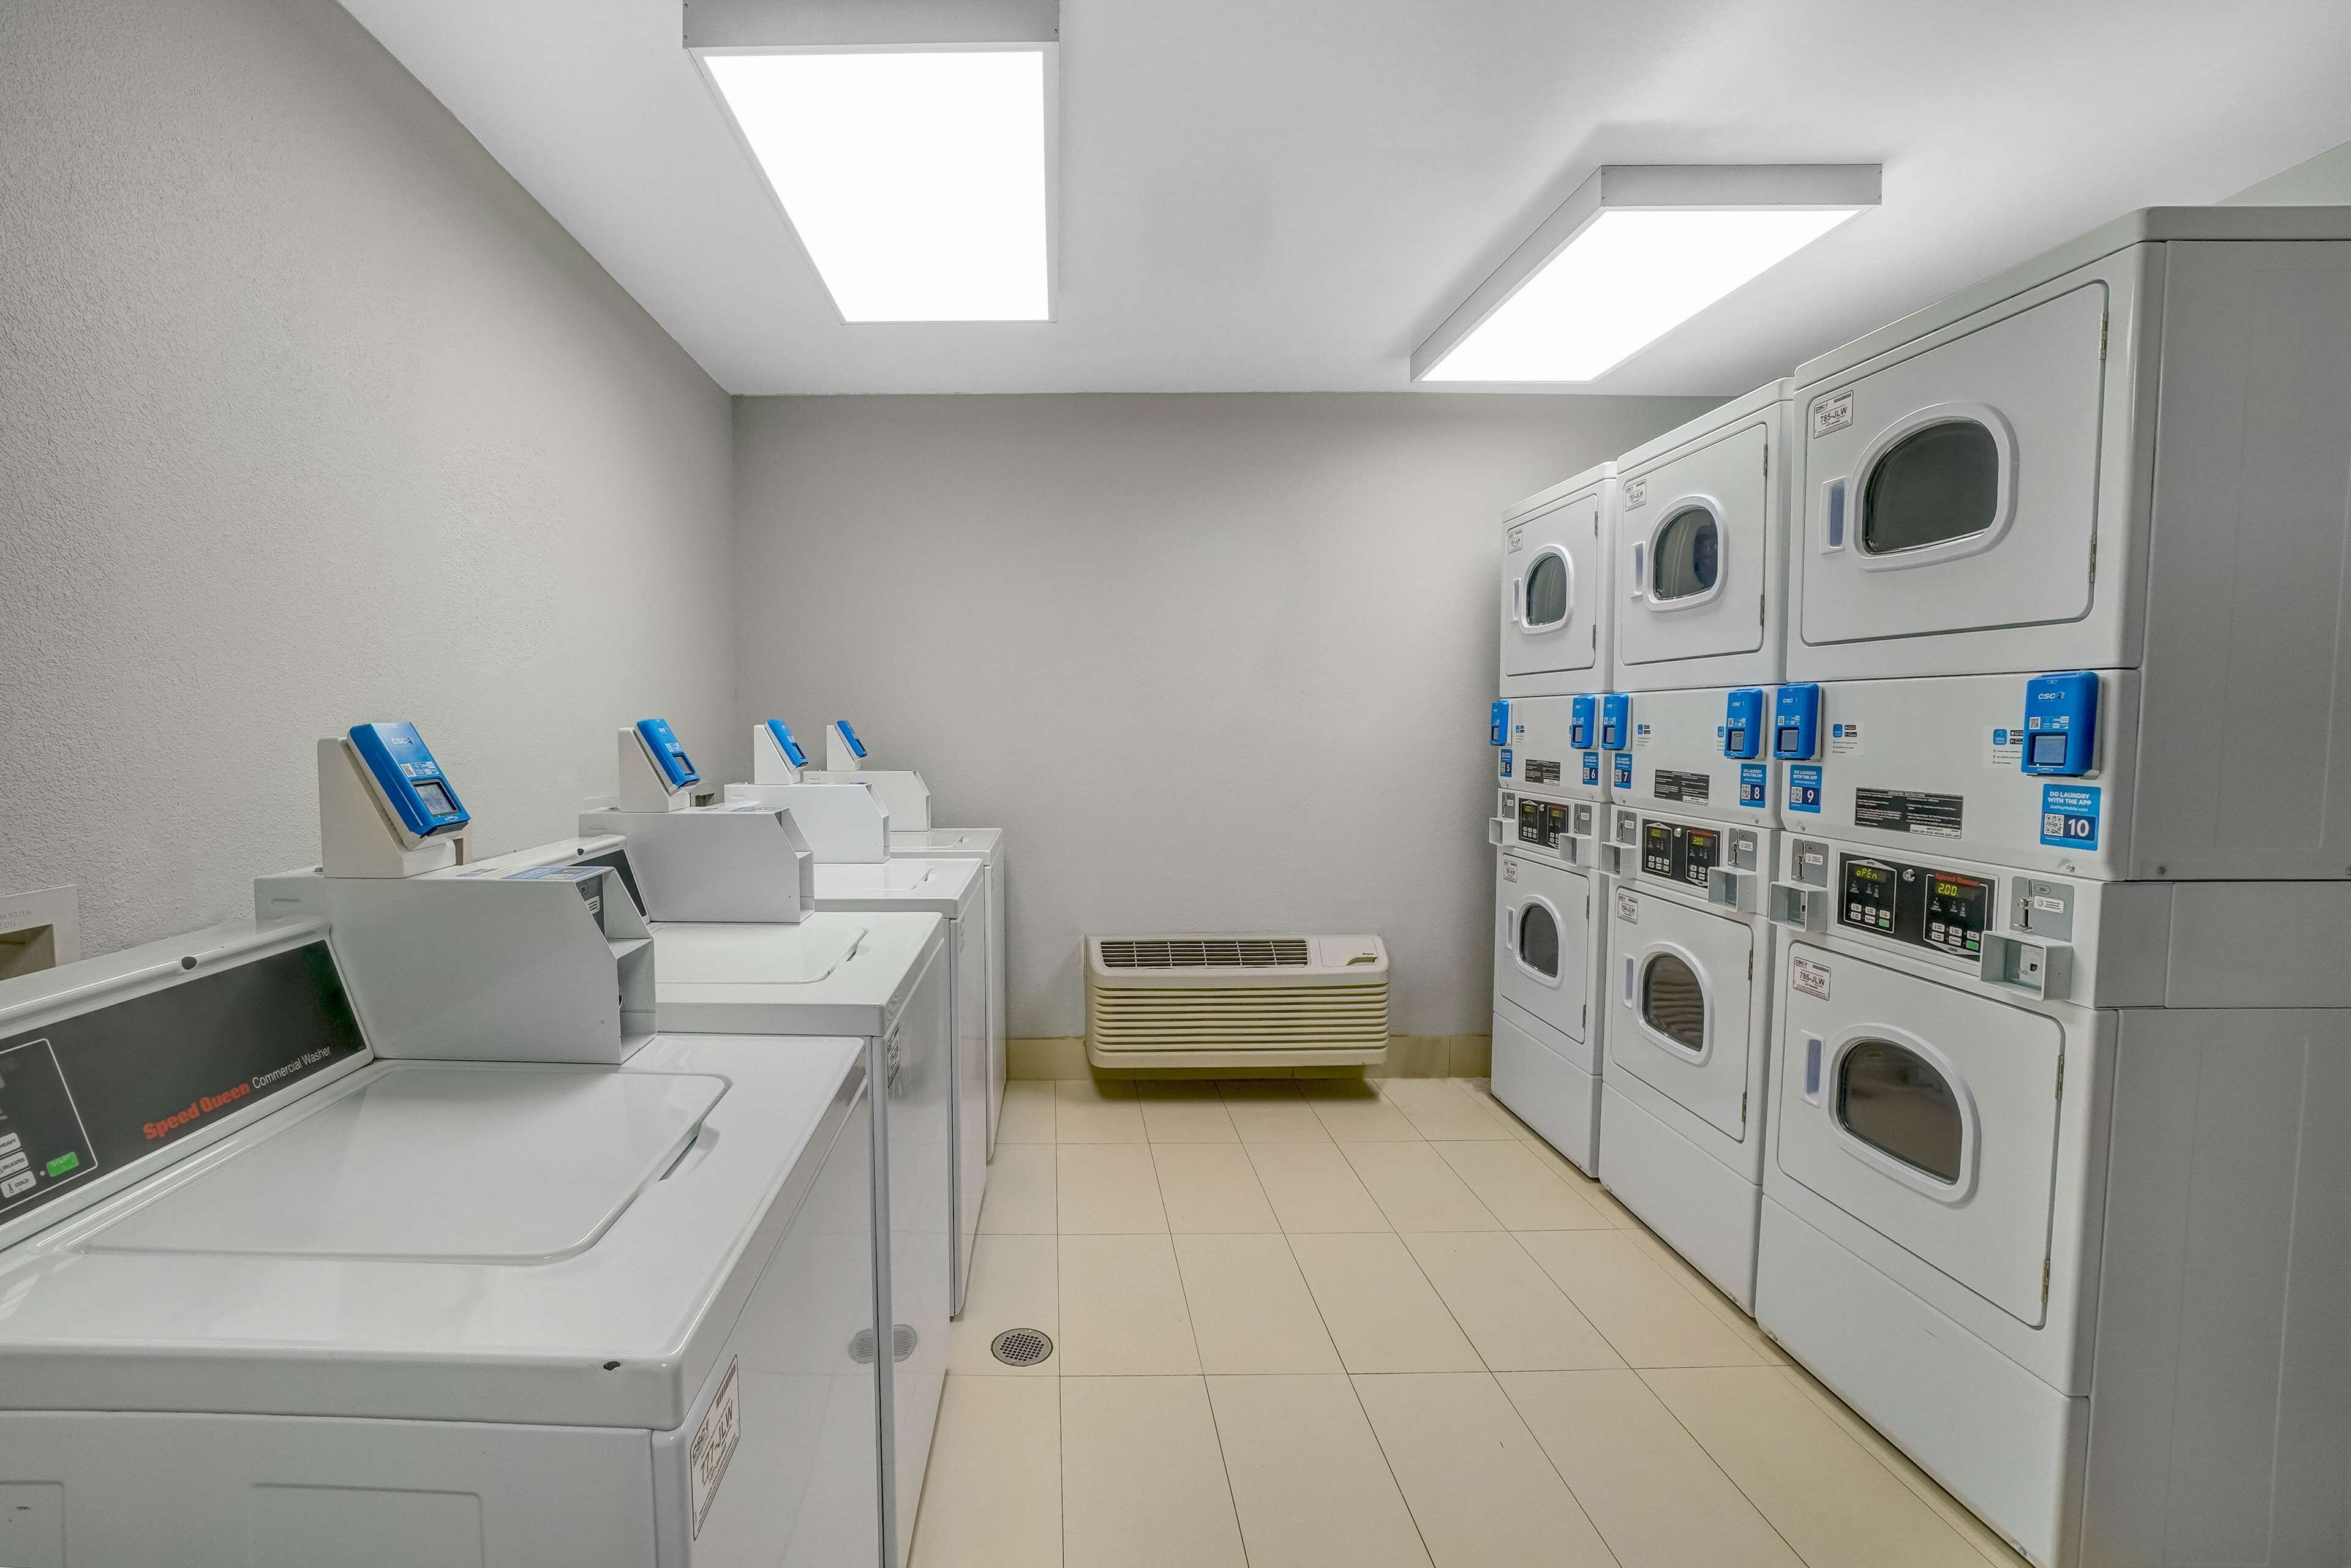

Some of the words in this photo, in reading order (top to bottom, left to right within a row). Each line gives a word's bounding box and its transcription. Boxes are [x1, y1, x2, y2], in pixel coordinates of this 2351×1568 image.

[1591, 770, 1596, 779] 6
[1623, 771, 1629, 782] 7
[1754, 787, 1760, 799] 8
[1807, 790, 1814, 803] 9
[2068, 819, 2090, 838] 10
[1938, 883, 1957, 896] 2.00
[143, 1102, 200, 1139] Speed
[200, 1082, 251, 1113] Queen
[252, 1058, 303, 1089] Commercial
[302, 1046, 332, 1067] Washer
[2, 1157, 25, 1170] DELICATES
[50, 1155, 72, 1166] START
[15, 1178, 29, 1187] COLD
[700, 1398, 733, 1487] 777-JLW
